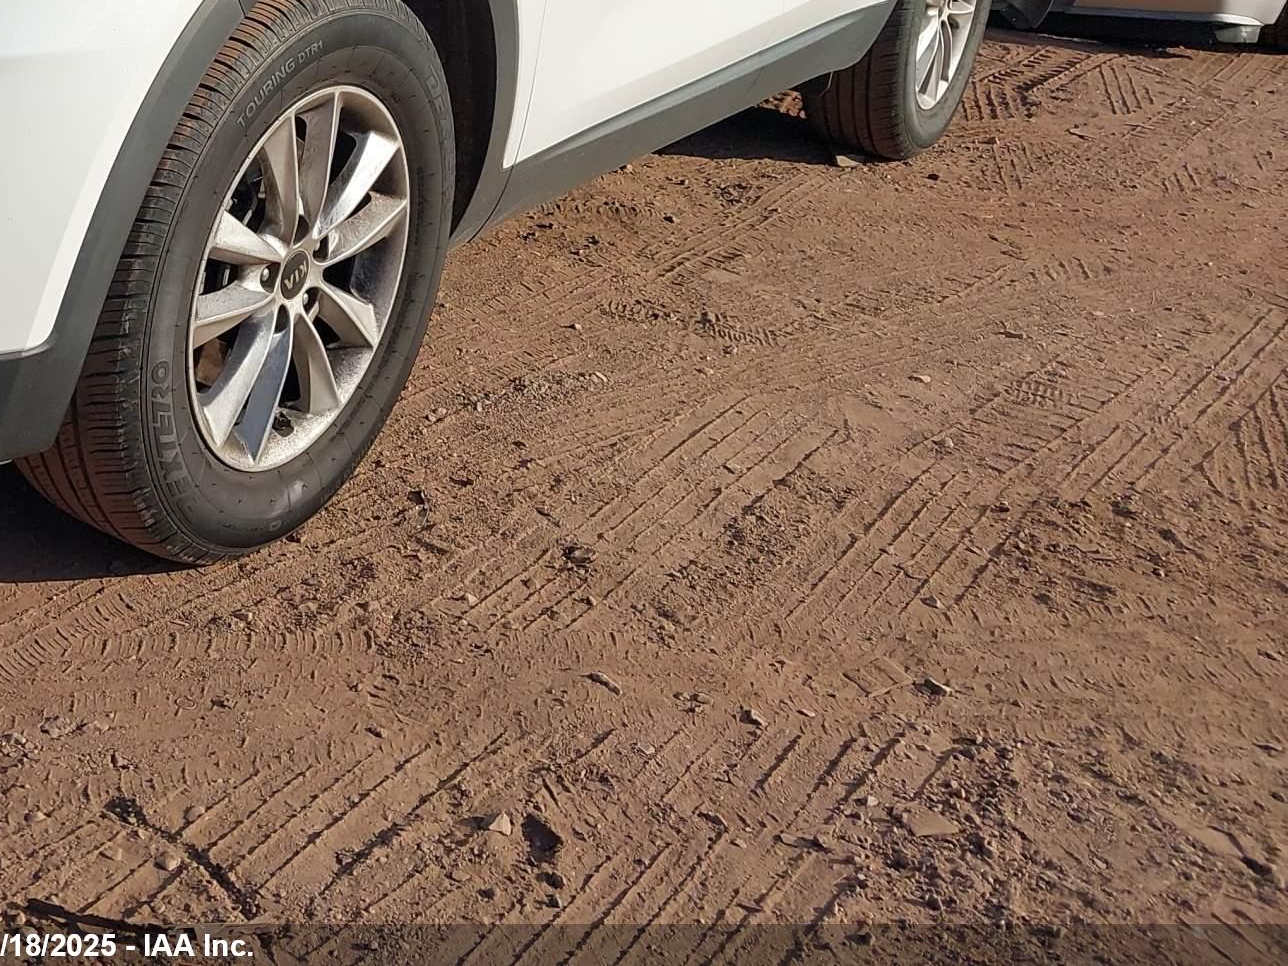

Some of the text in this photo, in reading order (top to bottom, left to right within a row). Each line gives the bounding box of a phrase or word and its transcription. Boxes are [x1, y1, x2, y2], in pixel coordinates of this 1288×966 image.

[237, 40, 323, 127] TOURING DTR1
[284, 260, 307, 289] KIA
